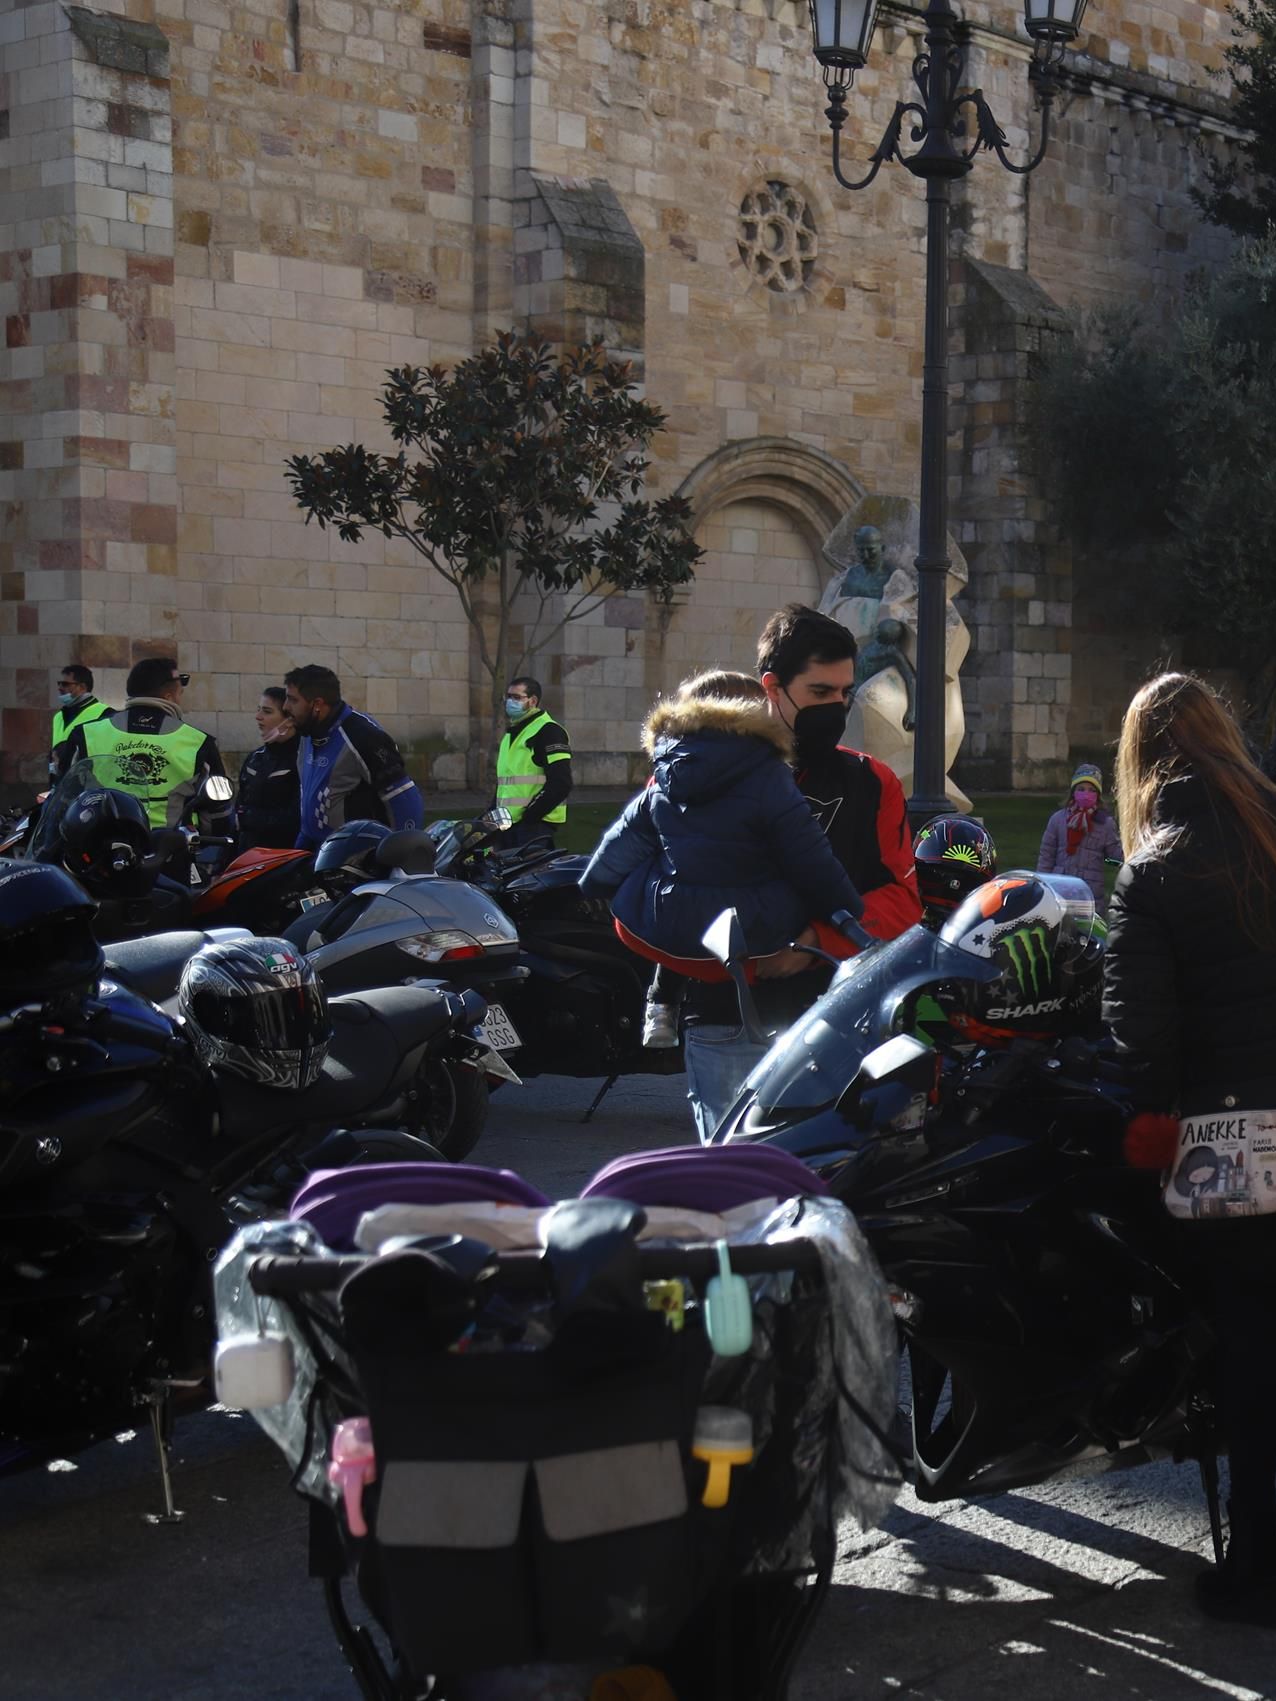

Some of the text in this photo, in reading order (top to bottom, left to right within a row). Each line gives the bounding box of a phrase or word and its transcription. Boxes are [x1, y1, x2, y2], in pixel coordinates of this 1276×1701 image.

[985, 996, 1067, 1020] SHARK
[487, 1028, 515, 1047] GSG
[1181, 1118, 1247, 1146] ANEKKE
